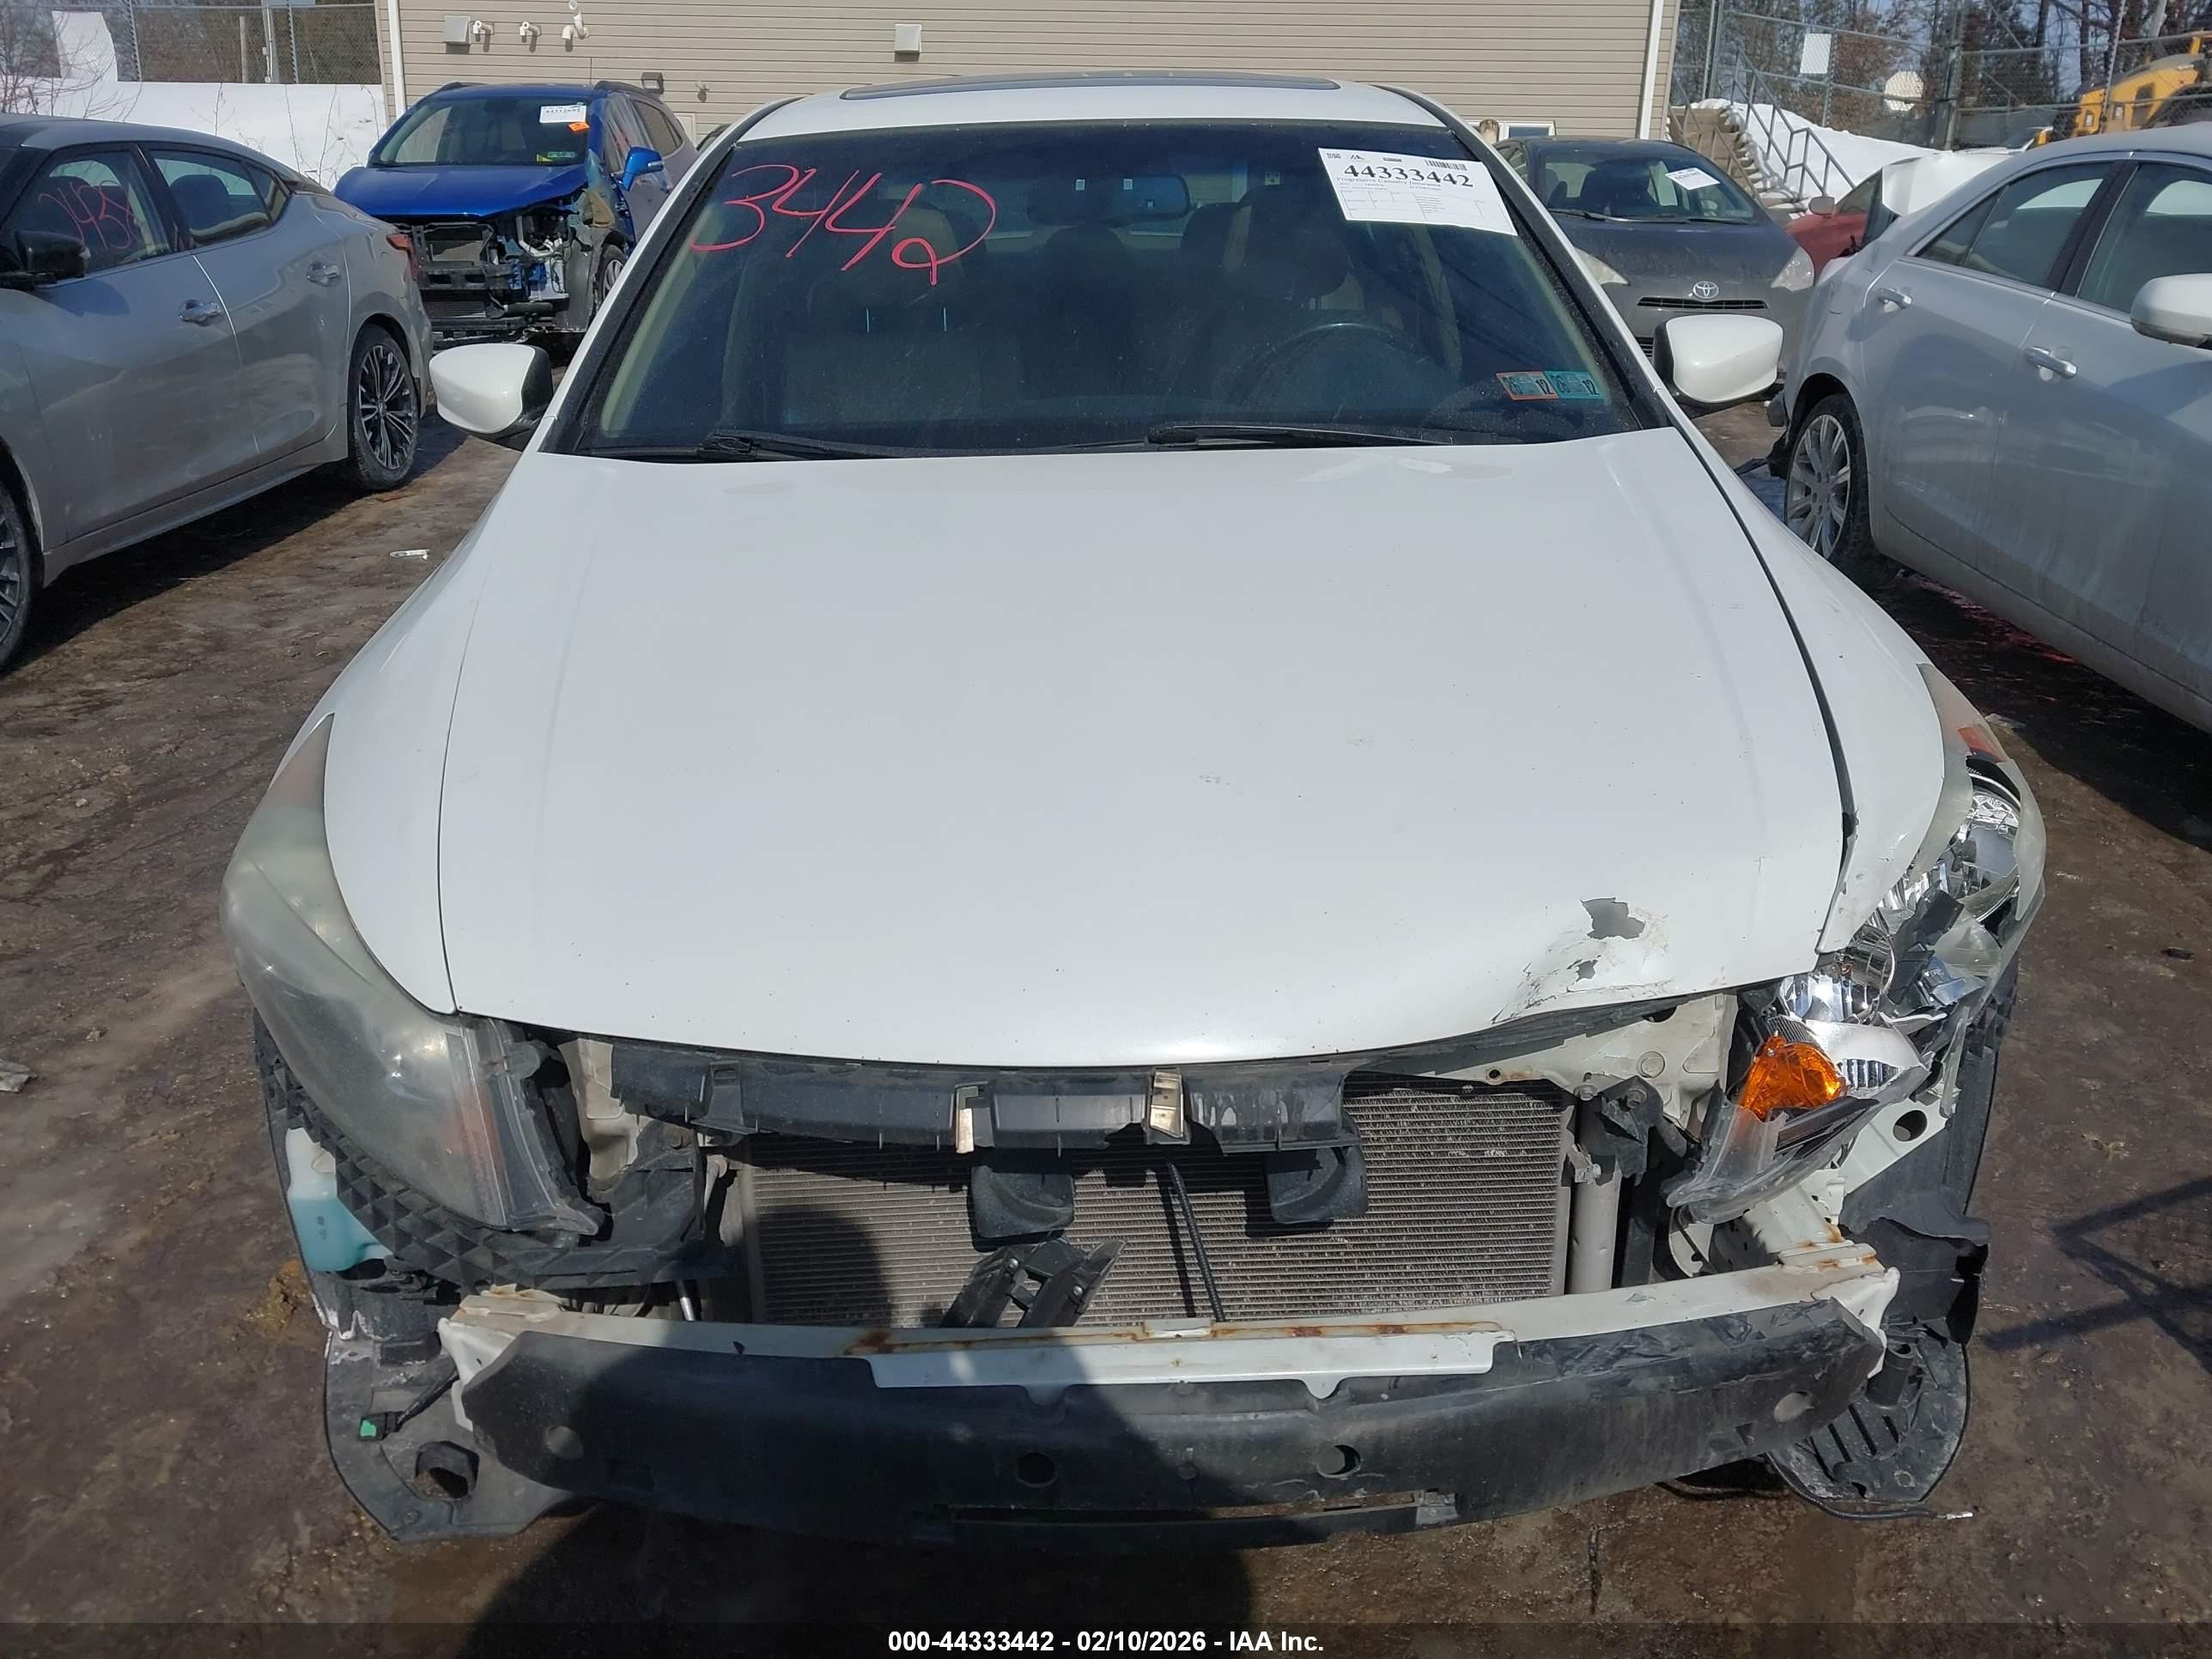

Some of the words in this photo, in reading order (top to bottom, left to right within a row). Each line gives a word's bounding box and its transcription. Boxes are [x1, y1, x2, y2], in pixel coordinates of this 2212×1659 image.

[1344, 165, 1474, 188] 44333442
[690, 164, 997, 286] 3442
[1534, 379, 1555, 395] 12
[1582, 379, 1601, 395] 12
